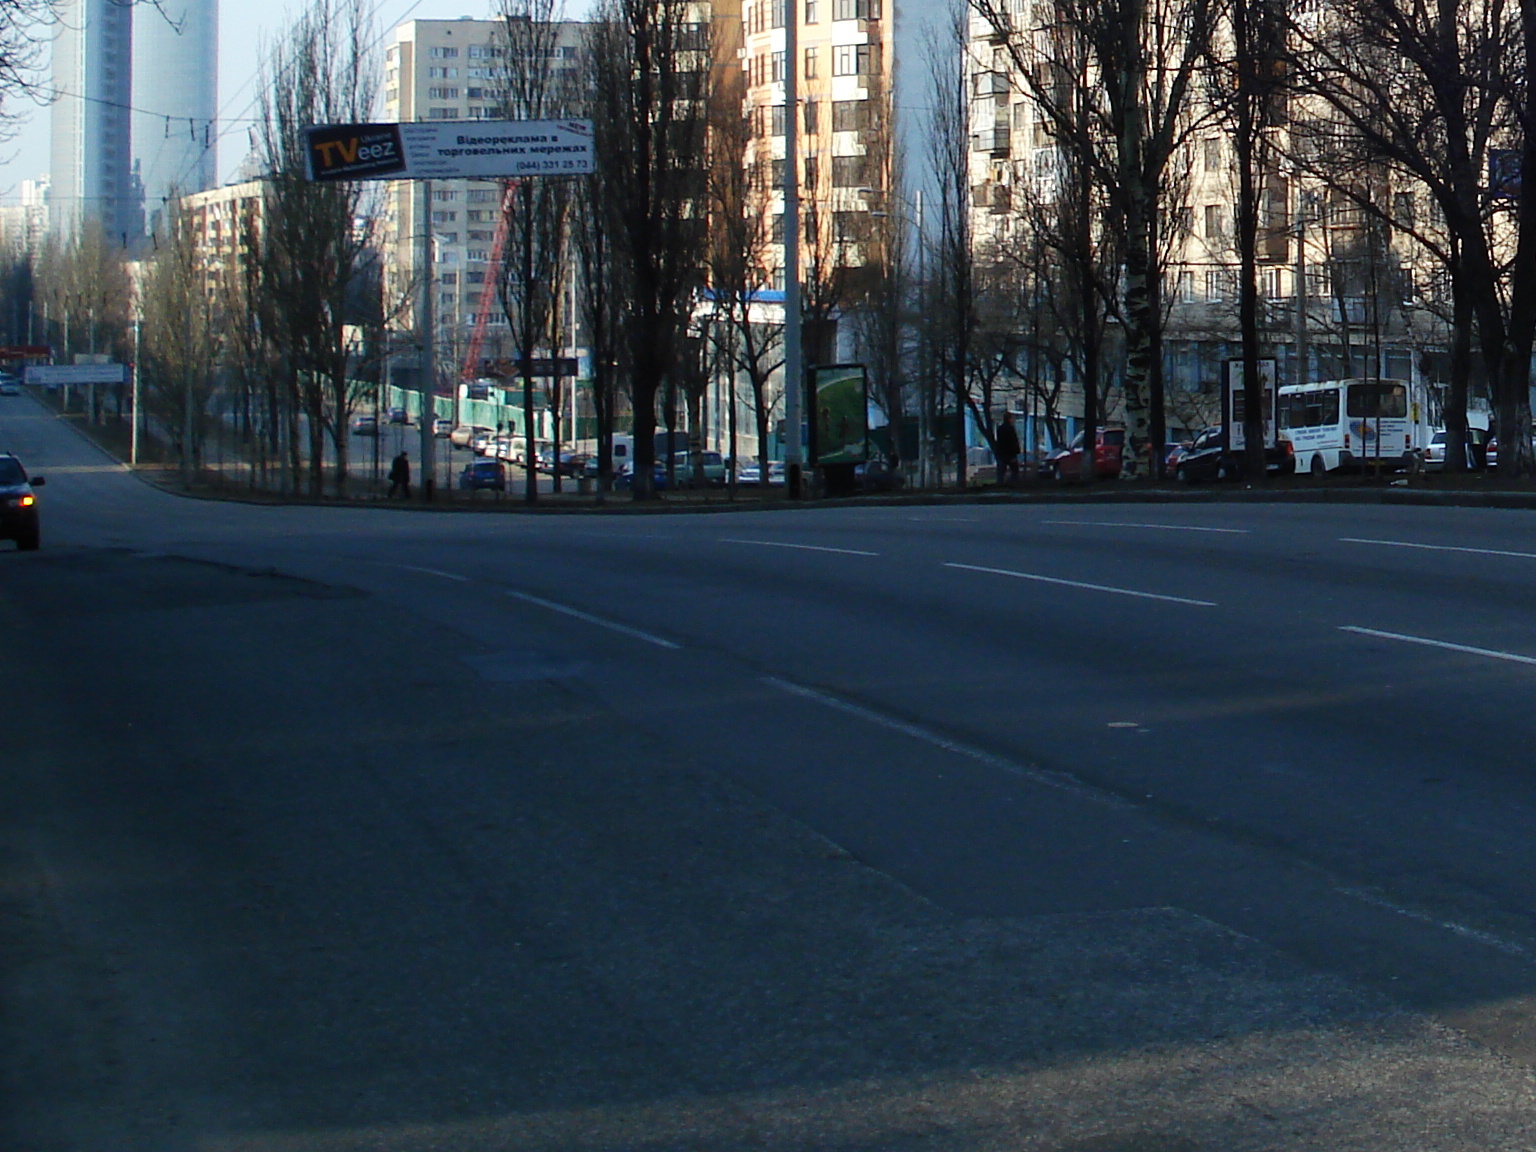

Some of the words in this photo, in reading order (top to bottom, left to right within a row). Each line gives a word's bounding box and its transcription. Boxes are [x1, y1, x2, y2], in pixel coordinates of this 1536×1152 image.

[456, 134, 548, 146] Відеореклама
[551, 135, 559, 143] в
[437, 147, 527, 157] торговельних
[530, 145, 588, 156] мережах
[516, 161, 541, 171] (044)
[542, 160, 560, 169] 331
[563, 160, 574, 169] 25
[576, 160, 588, 168] 73
